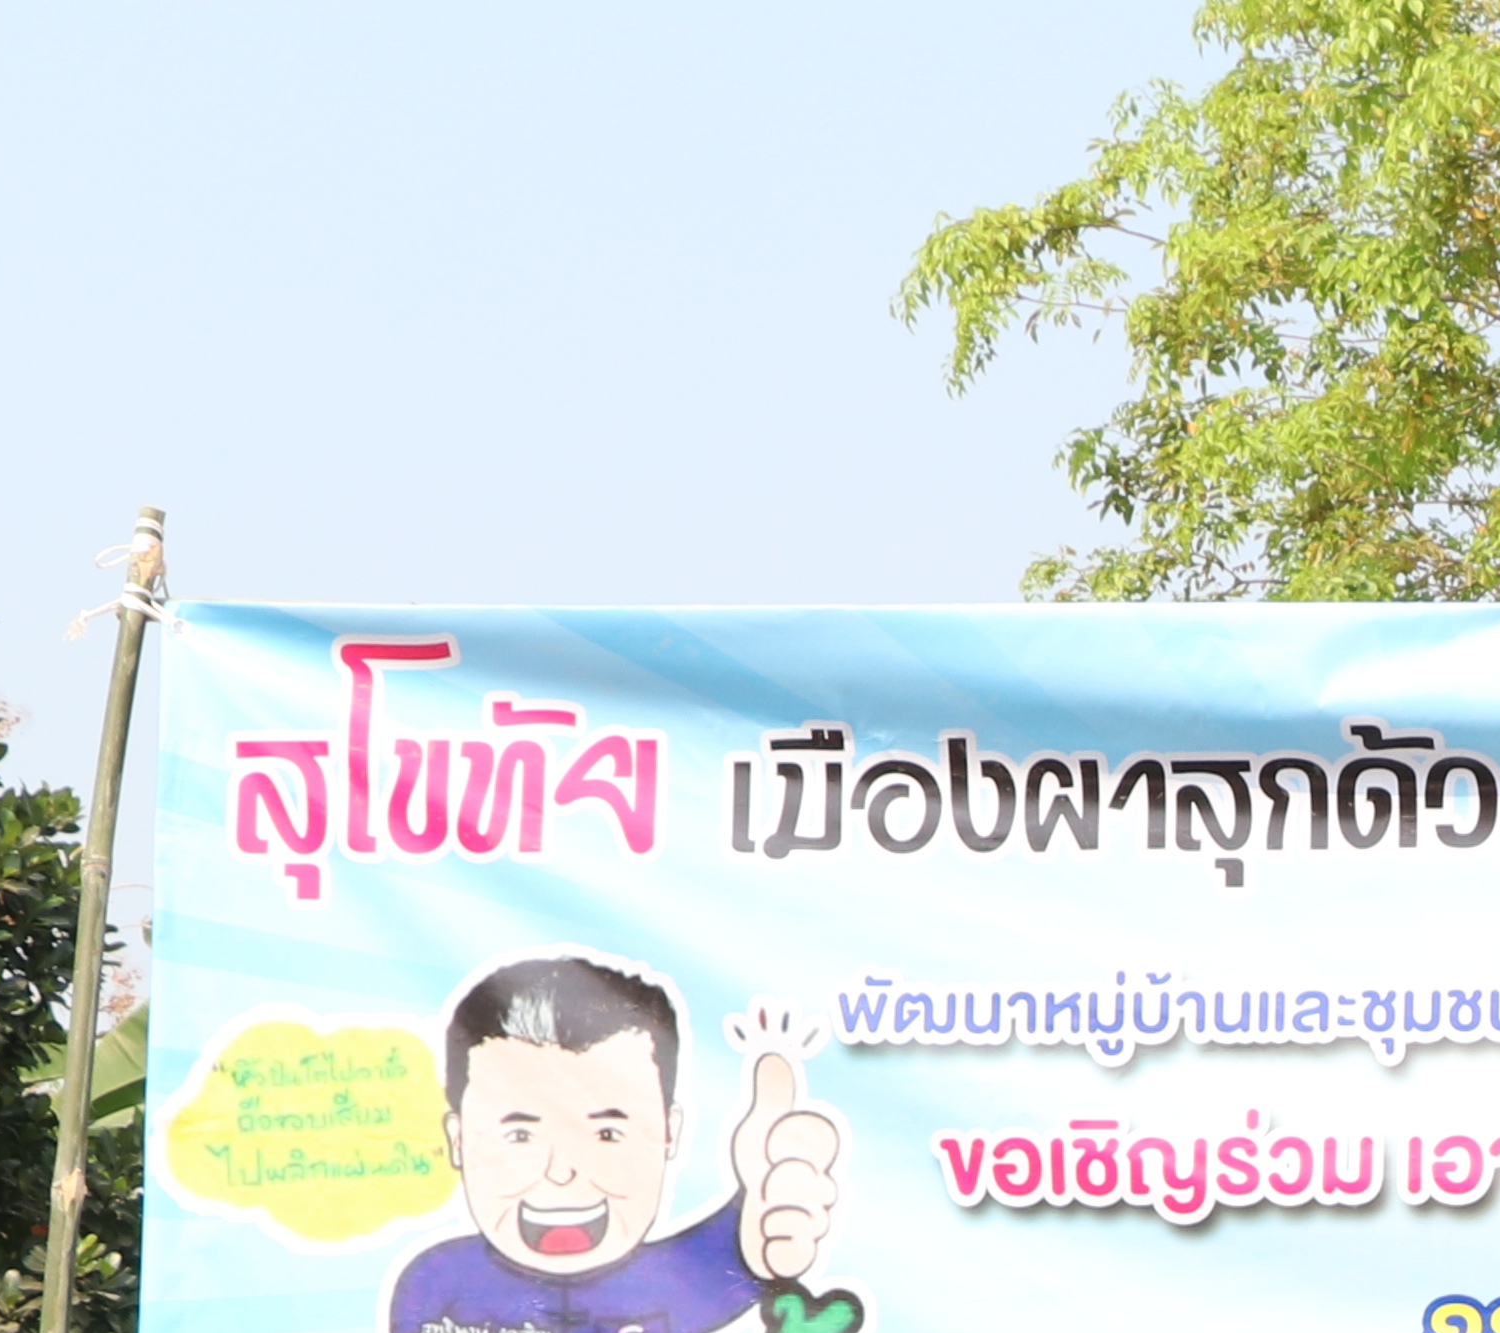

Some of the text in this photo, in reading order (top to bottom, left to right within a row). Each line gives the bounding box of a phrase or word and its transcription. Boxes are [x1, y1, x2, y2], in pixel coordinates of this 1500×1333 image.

[233, 640, 658, 902] สุโขทัย
[939, 1108, 1371, 1216] ขอเชิญร่วม
